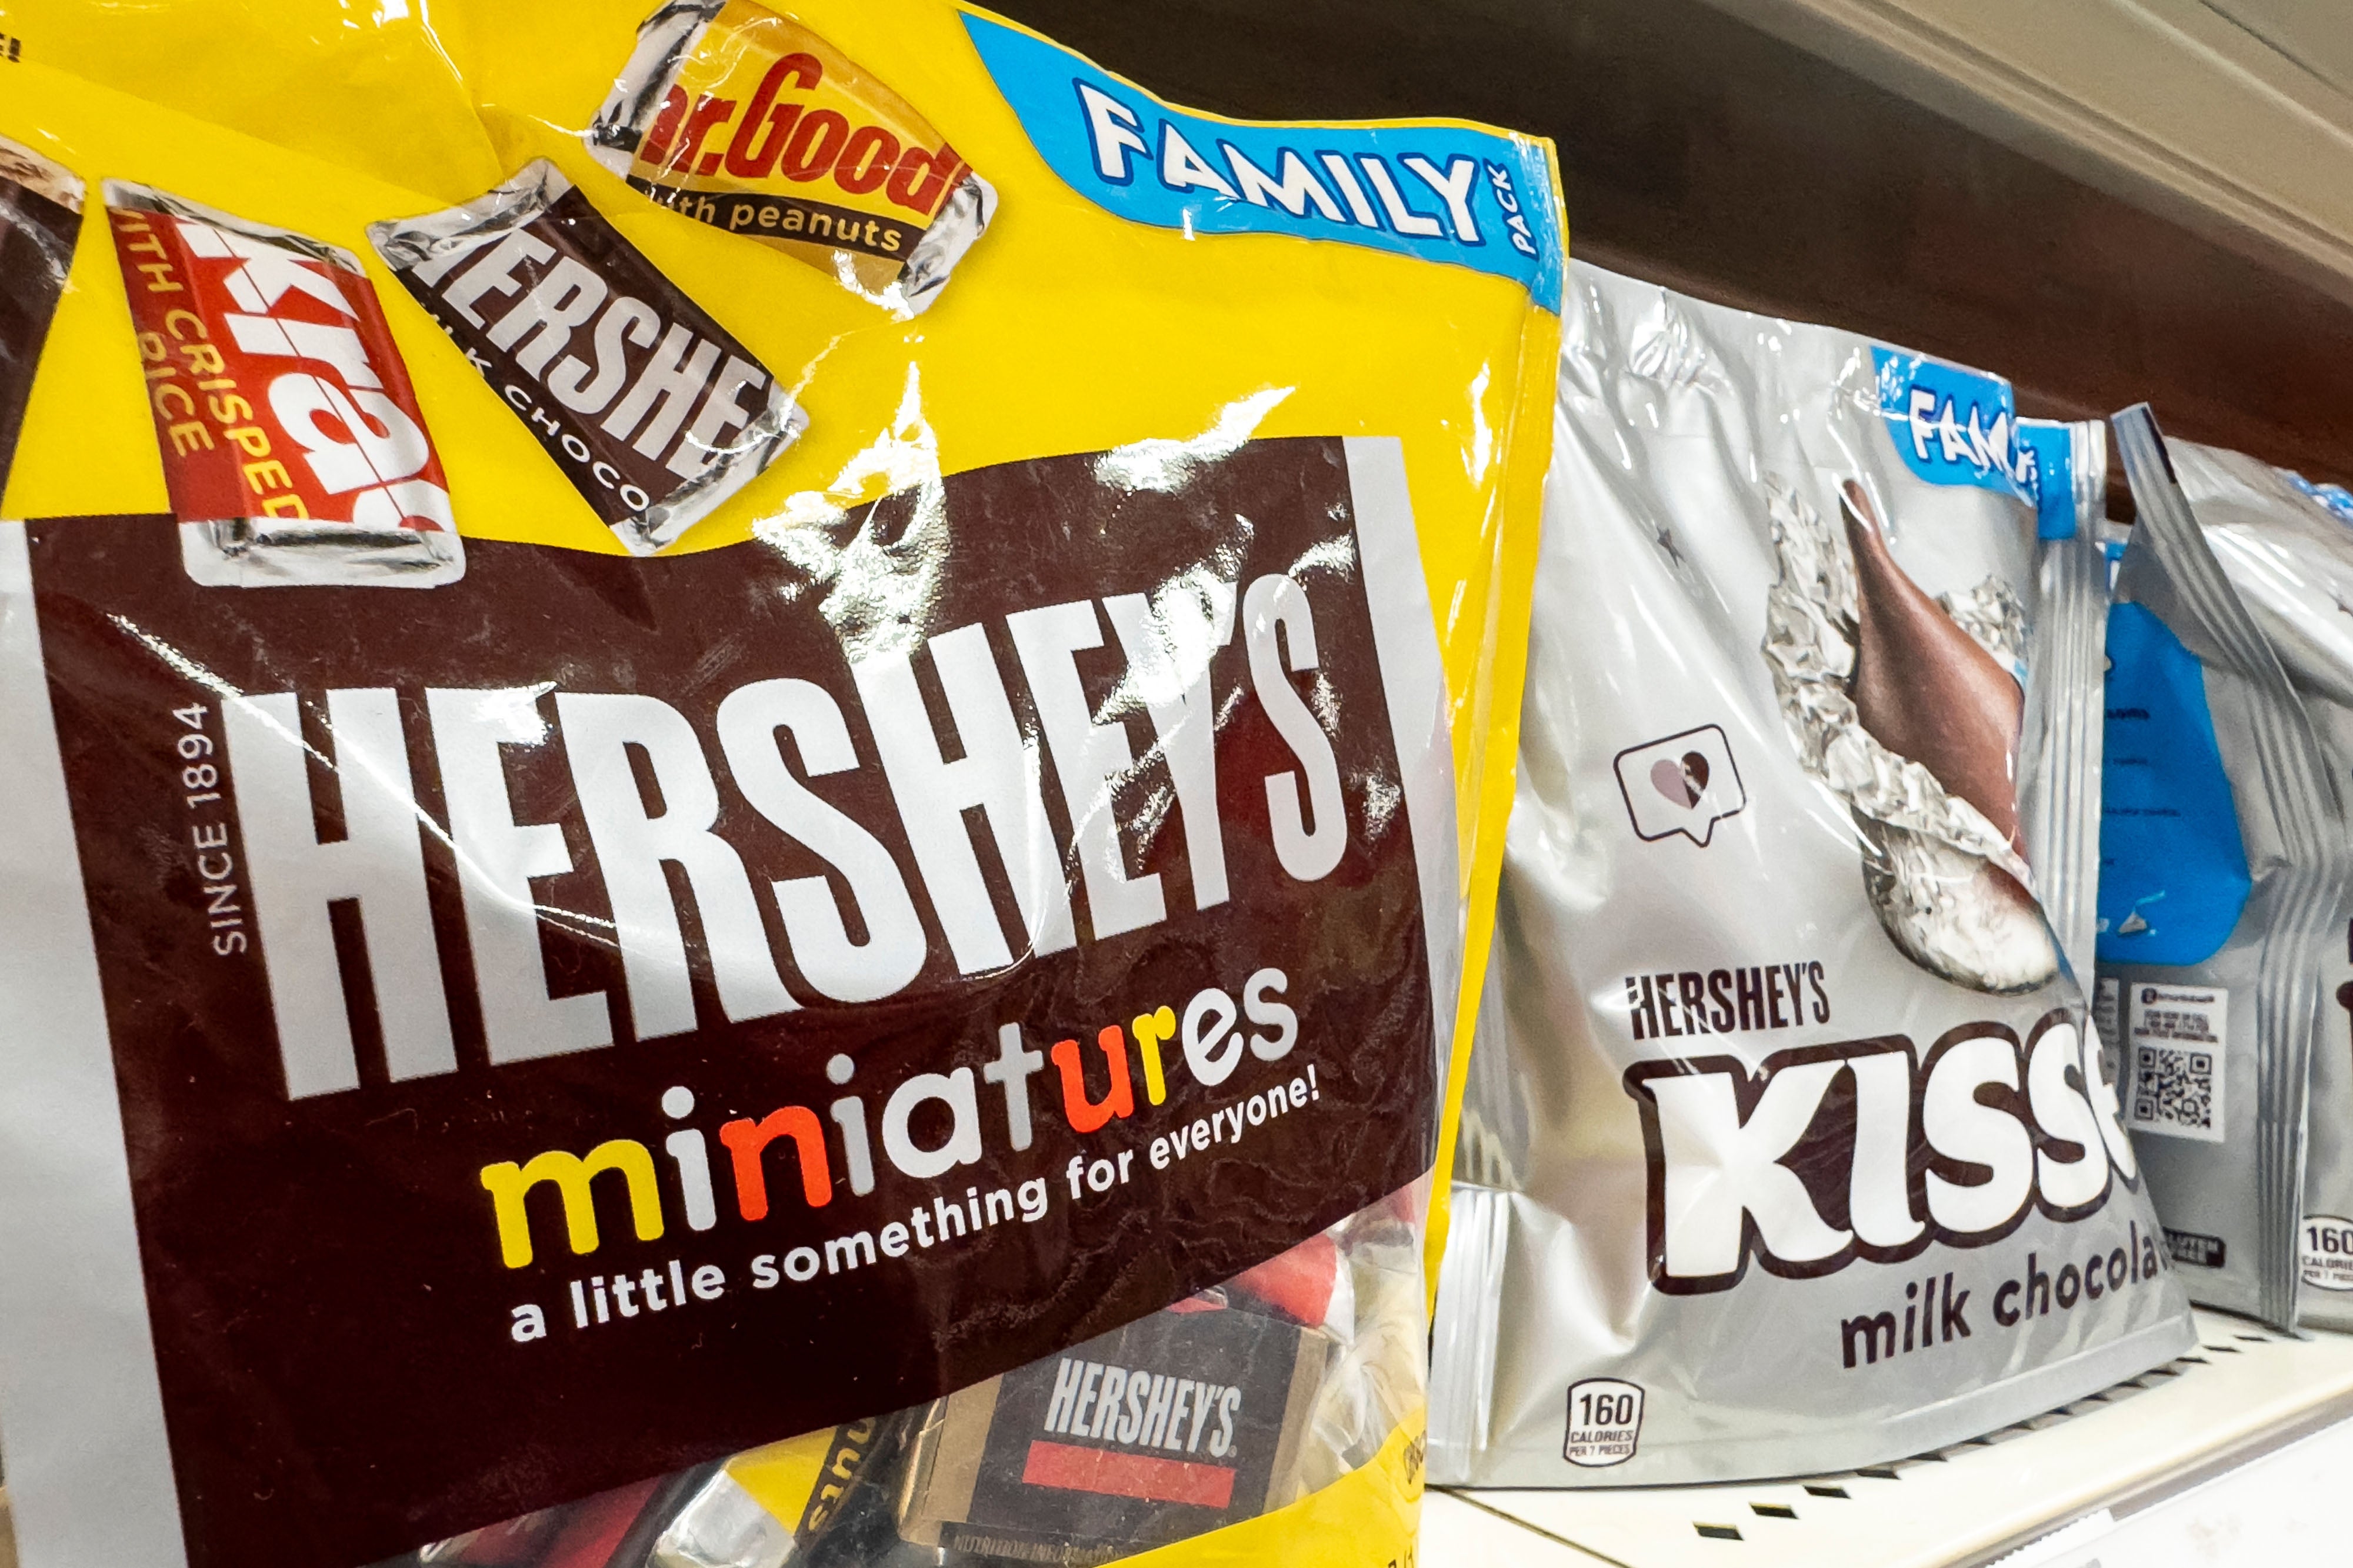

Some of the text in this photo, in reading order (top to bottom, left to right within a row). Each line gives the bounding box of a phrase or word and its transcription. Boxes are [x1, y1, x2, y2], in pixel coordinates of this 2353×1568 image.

[1079, 84, 1480, 242] FAMILY
[1487, 165, 1536, 254] PACK
[729, 203, 902, 252] peanuts
[505, 384, 650, 512] CHOCO
[175, 703, 248, 956] SINCE 1894
[221, 573, 1349, 1101] HERSHEY'S
[1625, 960, 1830, 1040] HERSHEY'S
[479, 968, 1298, 1269] miniatures
[511, 1063, 1321, 1343] a little something for everyone!
[1841, 1220, 2168, 1369] milk chocola
[1044, 1357, 1241, 1458] HERSHEY'S
[1569, 1446, 1587, 1456] PER
[1598, 1444, 1630, 1455] PIECES
[1571, 1430, 1634, 1443] CALORIES
[1579, 1394, 1634, 1426] 160
